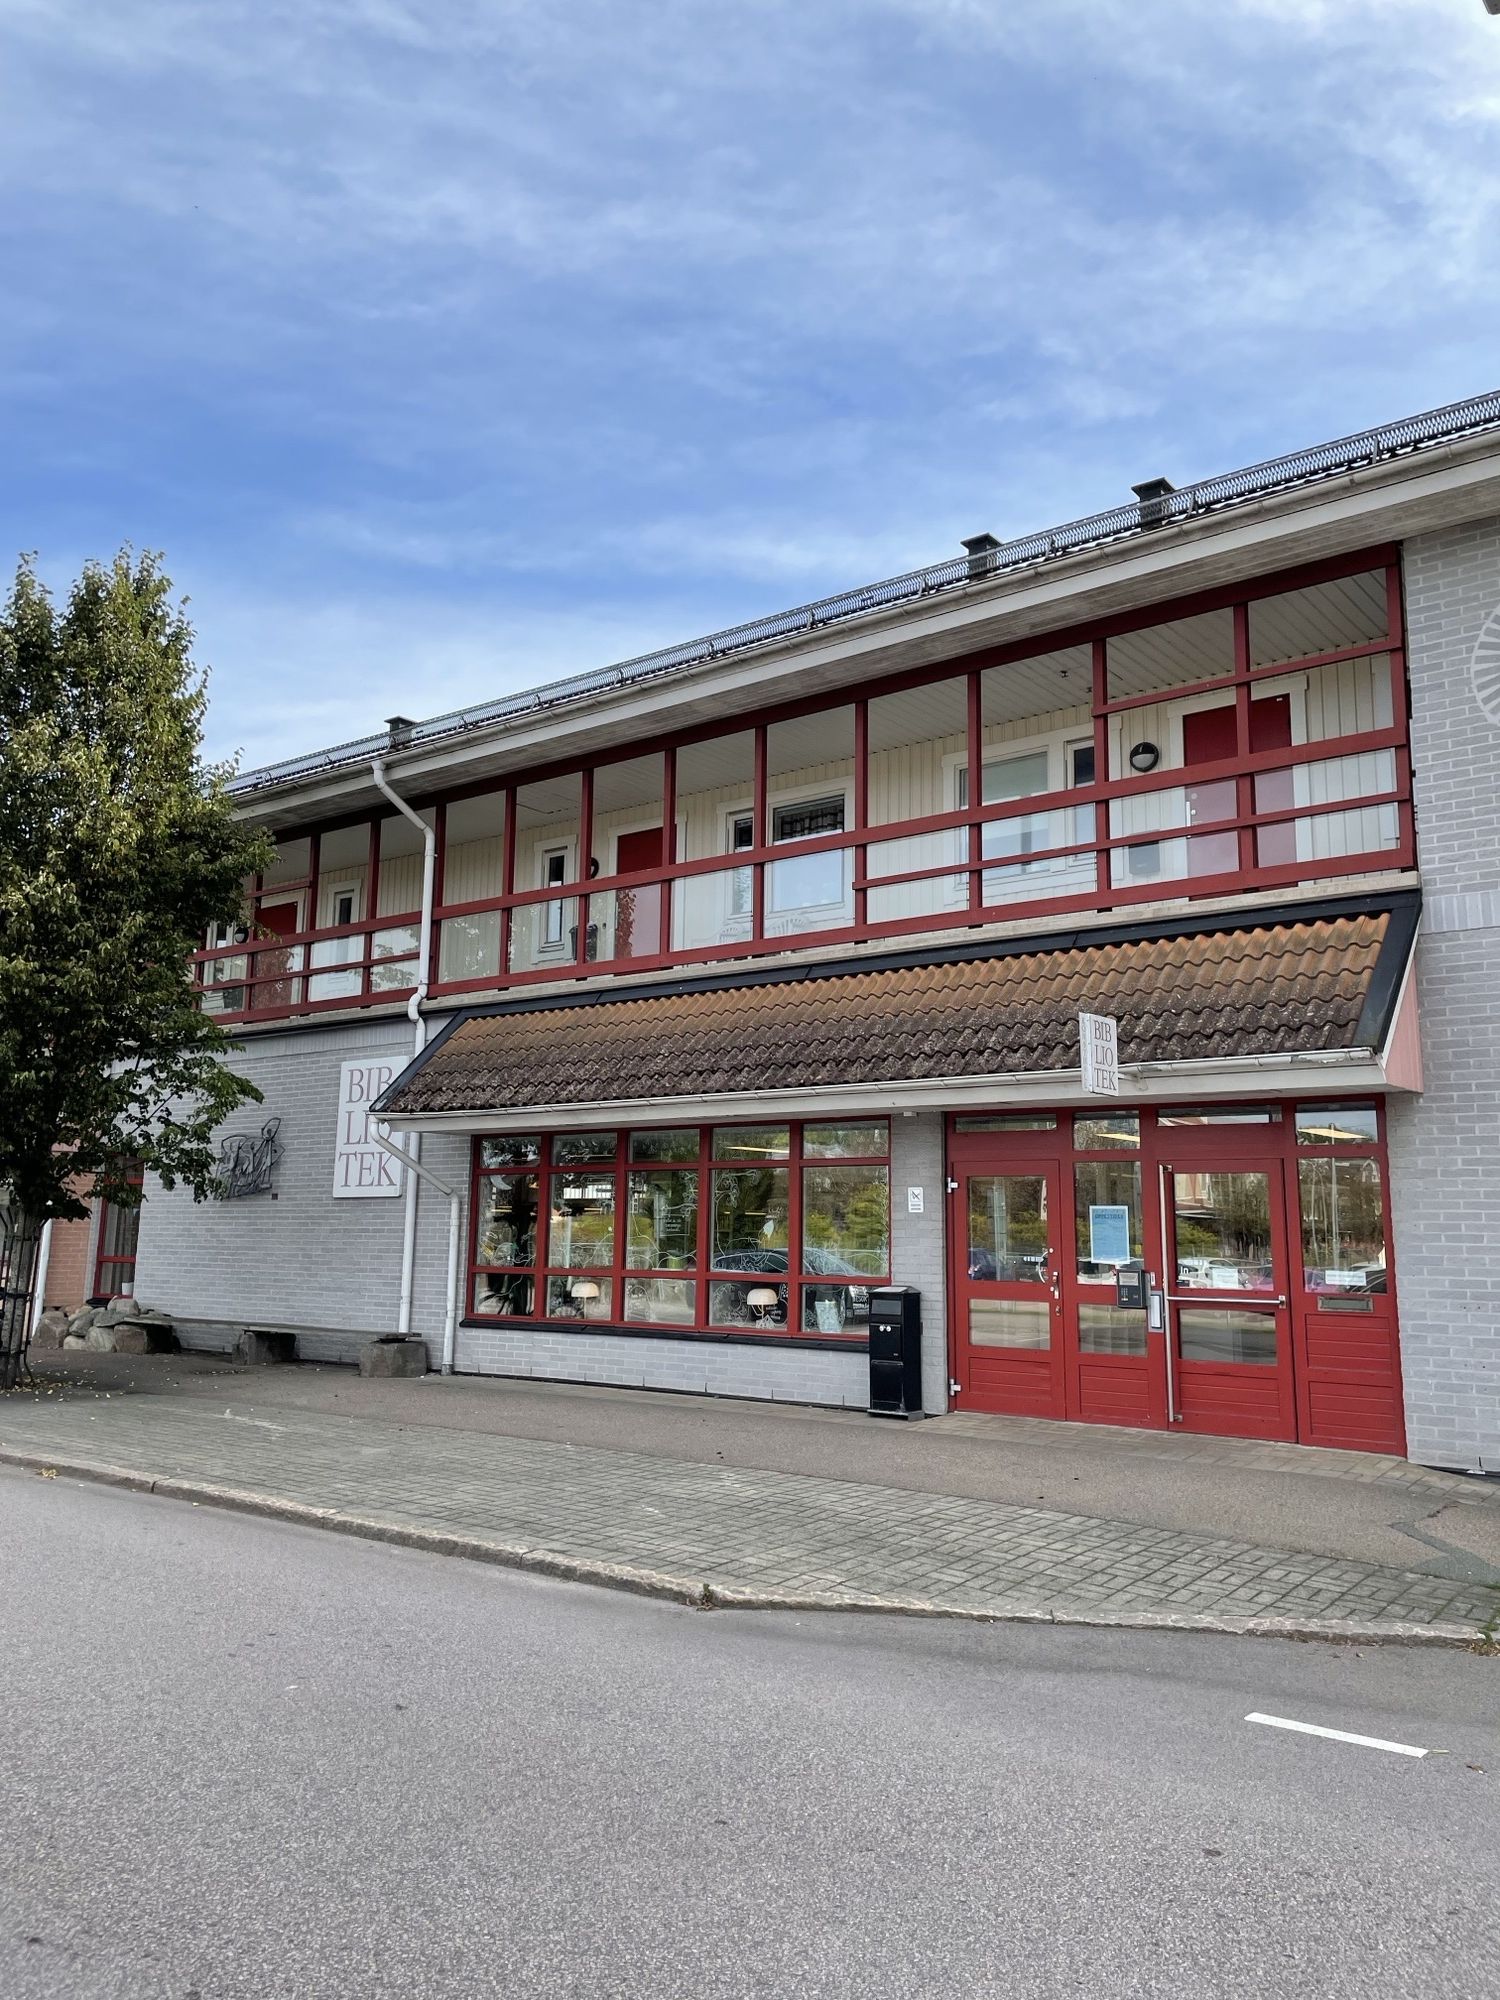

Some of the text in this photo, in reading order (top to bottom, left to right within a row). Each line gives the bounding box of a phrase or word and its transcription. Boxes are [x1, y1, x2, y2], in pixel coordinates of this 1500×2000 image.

[1094, 1020, 1112, 1042] BIB
[1095, 1045, 1113, 1067] LIO
[346, 1066, 393, 1103] BIB
[1094, 1068, 1116, 1091] TEK
[338, 1151, 397, 1187] TEK
